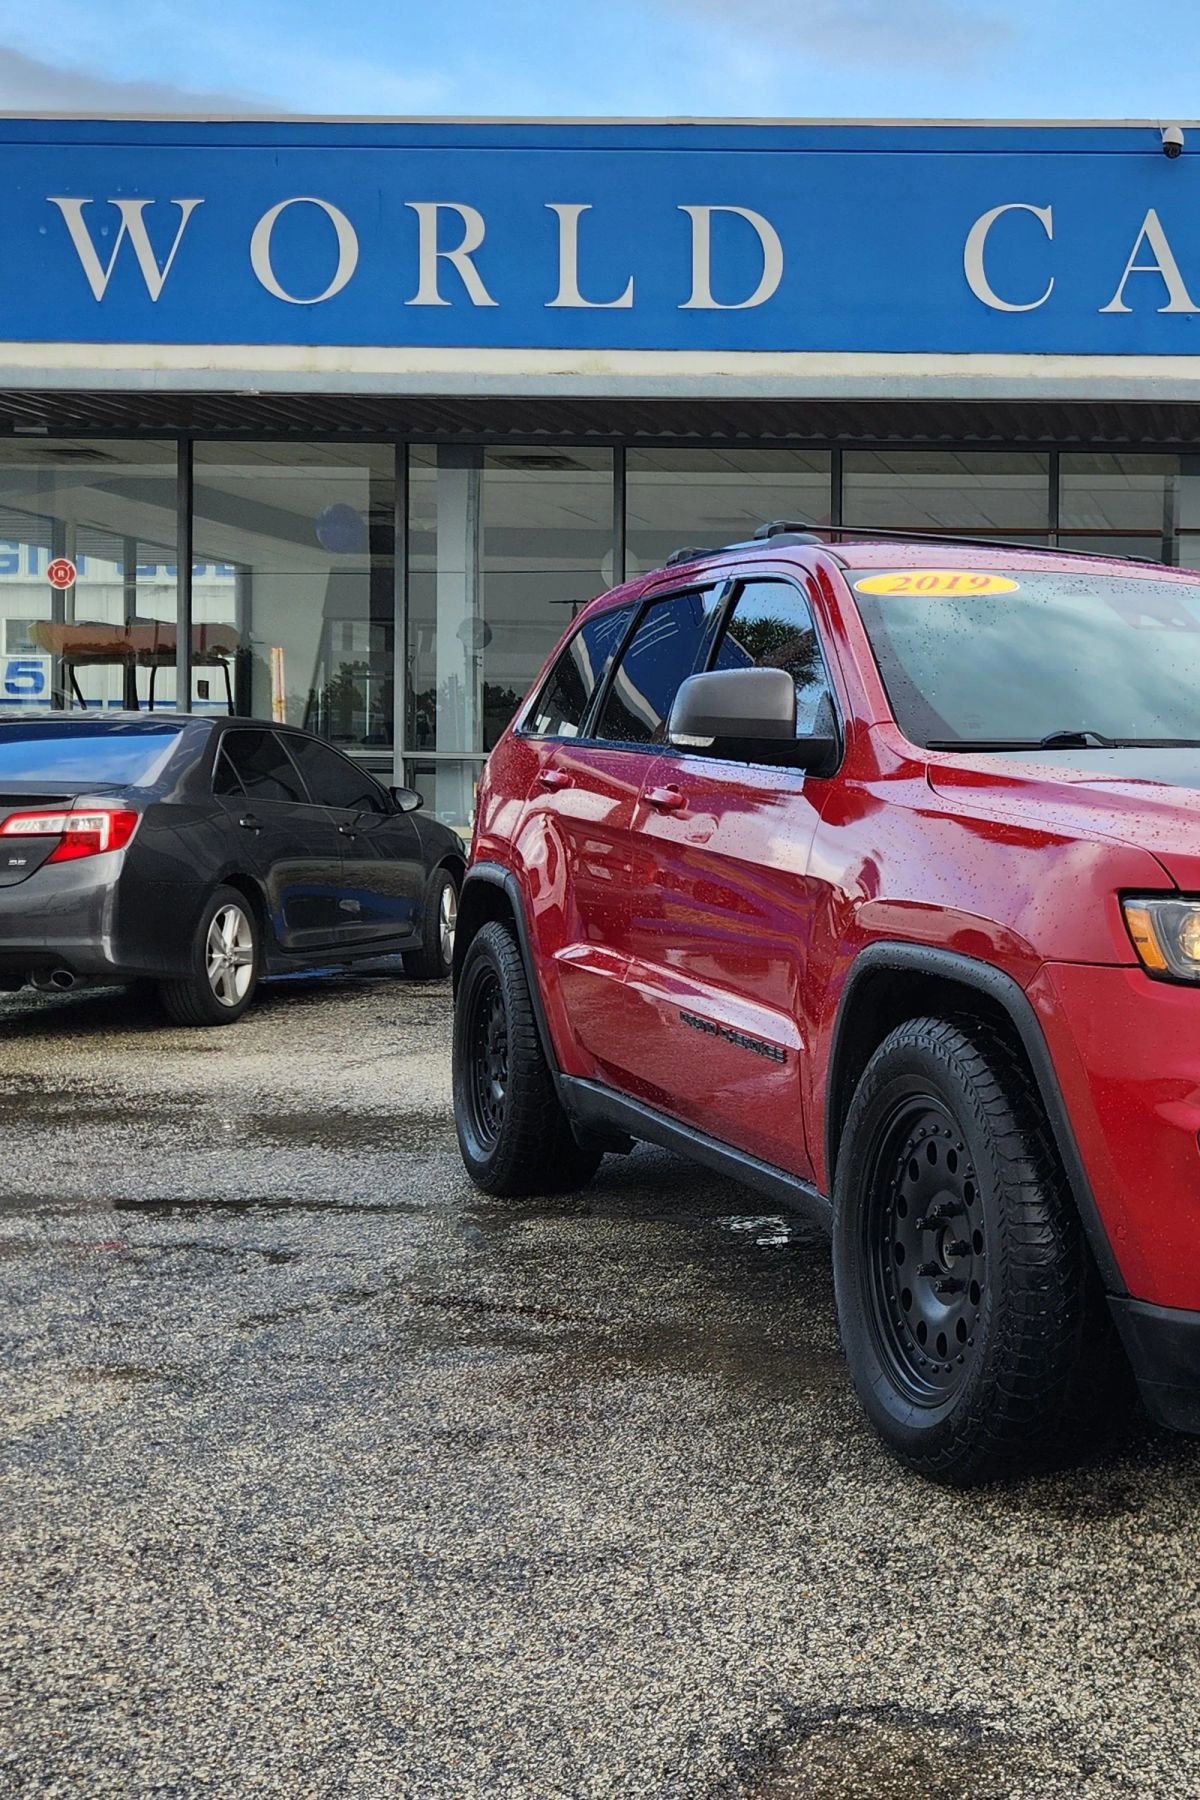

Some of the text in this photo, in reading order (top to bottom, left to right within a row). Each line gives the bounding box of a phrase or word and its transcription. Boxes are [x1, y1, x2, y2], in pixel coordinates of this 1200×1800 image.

[47, 197, 784, 309] WORLD
[887, 575, 991, 592] 2019
[4, 661, 45, 694] 5
